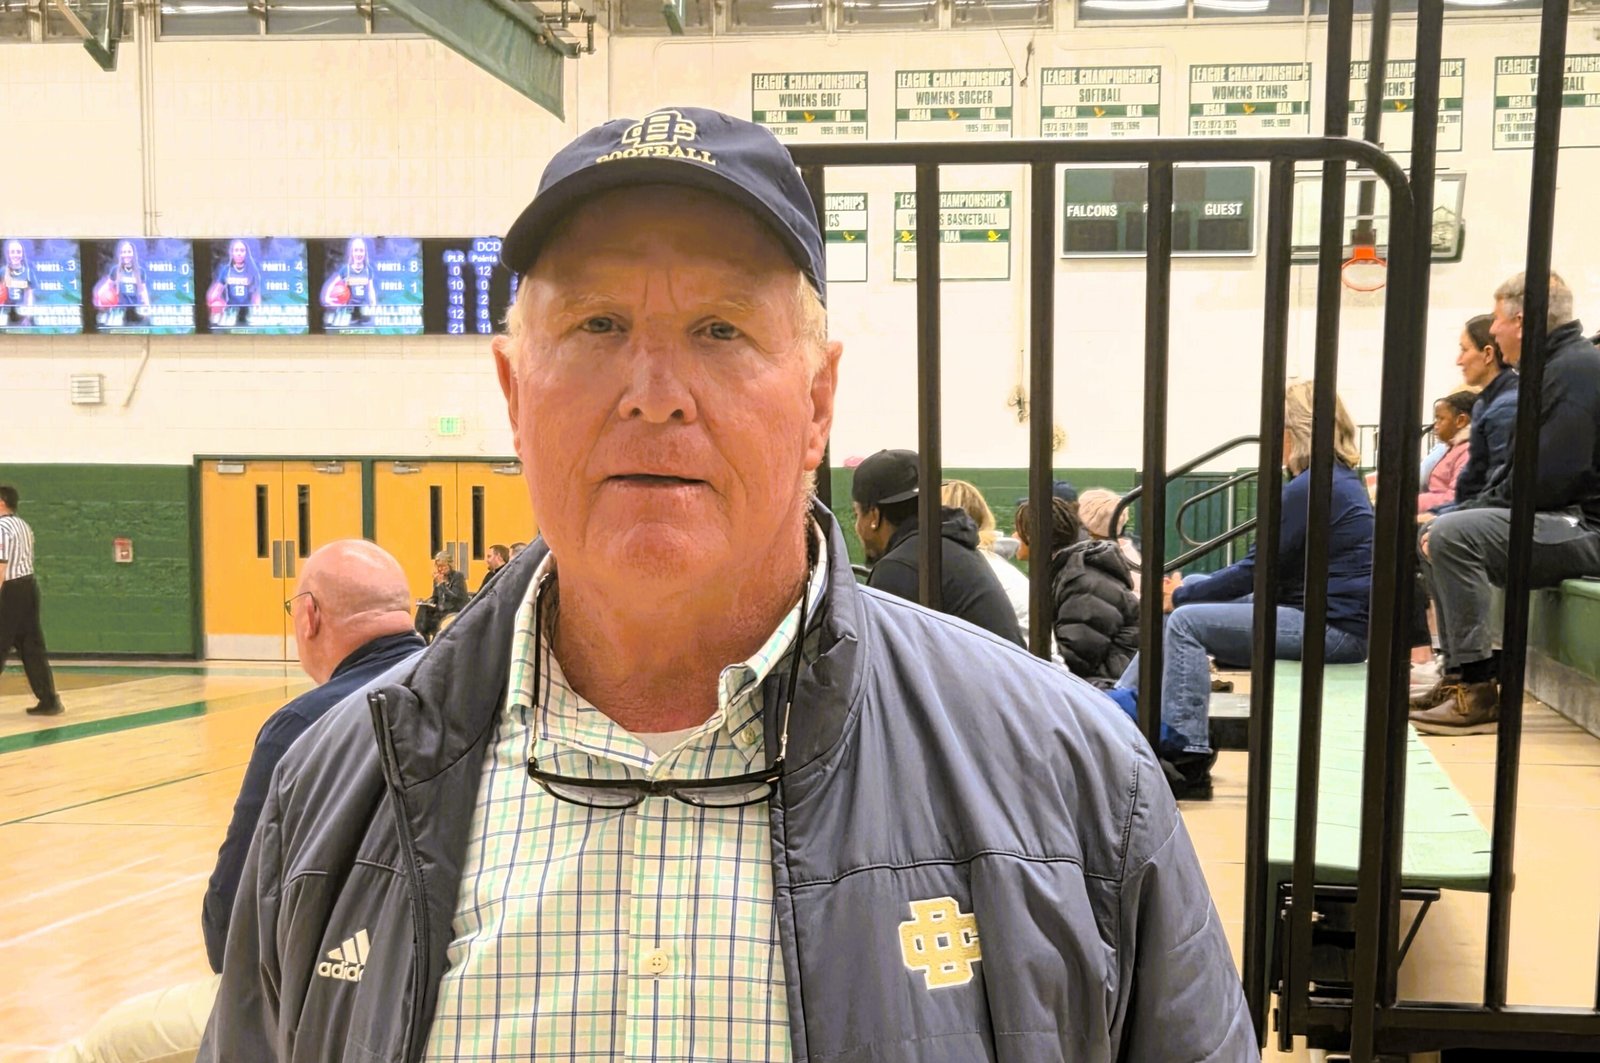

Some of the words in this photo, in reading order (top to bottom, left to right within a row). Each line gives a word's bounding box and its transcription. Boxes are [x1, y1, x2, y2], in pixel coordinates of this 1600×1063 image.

[897, 72, 931, 88] LEAGUE
[932, 71, 1011, 87] CHAMPIONSHIPS
[1043, 69, 1078, 84] LEAGUE
[1079, 68, 1158, 84] CHAMPIONSHIPS
[1192, 67, 1226, 82] LEAGUE
[755, 75, 788, 89] LEAGUE
[789, 74, 865, 89] CHAMPIONSHIPS
[916, 91, 955, 105] WOMENS
[958, 90, 993, 105] SOCCER
[1079, 88, 1120, 102] SOFTBALL
[1212, 86, 1252, 100] WOMENS
[1256, 84, 1288, 99] TENNIS
[779, 93, 817, 107] WOMENS
[821, 92, 841, 107] GOLF
[940, 192, 1006, 208] HAMPIONSHIPS
[1066, 204, 1118, 218] FALCONS
[1204, 202, 1243, 216] GUEST
[947, 213, 997, 226] BASKETBALL
[477, 241, 502, 252] DCD
[447, 254, 464, 263] PLR
[472, 254, 498, 263] Points
[67, 260, 77, 271] 3
[181, 263, 190, 275] 0
[295, 261, 304, 271] 4
[410, 260, 418, 273] 8
[453, 265, 460, 276] 0
[478, 266, 491, 276] 12
[69, 278, 77, 290] 1
[183, 281, 190, 293] 1
[295, 282, 304, 294] 3
[411, 281, 417, 293] 1
[451, 280, 464, 290] 10
[481, 280, 488, 290] 0
[453, 294, 463, 305] 11
[481, 294, 488, 305] 2
[451, 308, 464, 319] 12
[481, 308, 488, 319] 8
[451, 323, 463, 334] 21
[480, 323, 491, 334] 11
